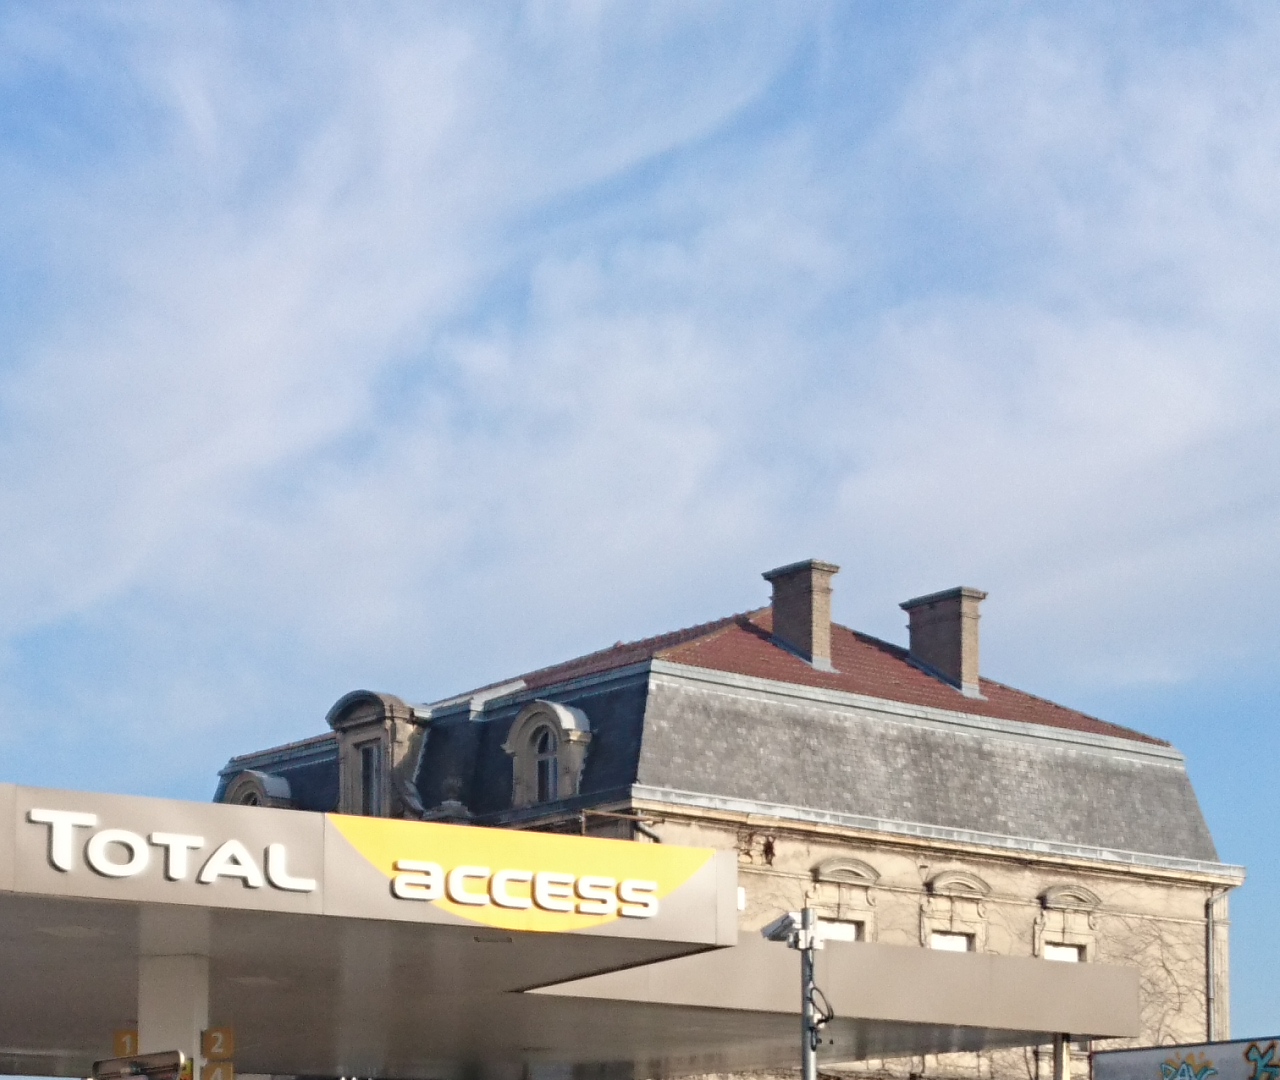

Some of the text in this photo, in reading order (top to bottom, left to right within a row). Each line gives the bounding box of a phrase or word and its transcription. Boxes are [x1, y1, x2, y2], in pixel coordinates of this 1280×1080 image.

[26, 807, 318, 894] TOTAL
[391, 858, 661, 918] access
[122, 1034, 132, 1055] 1
[211, 1031, 224, 1053] 2
